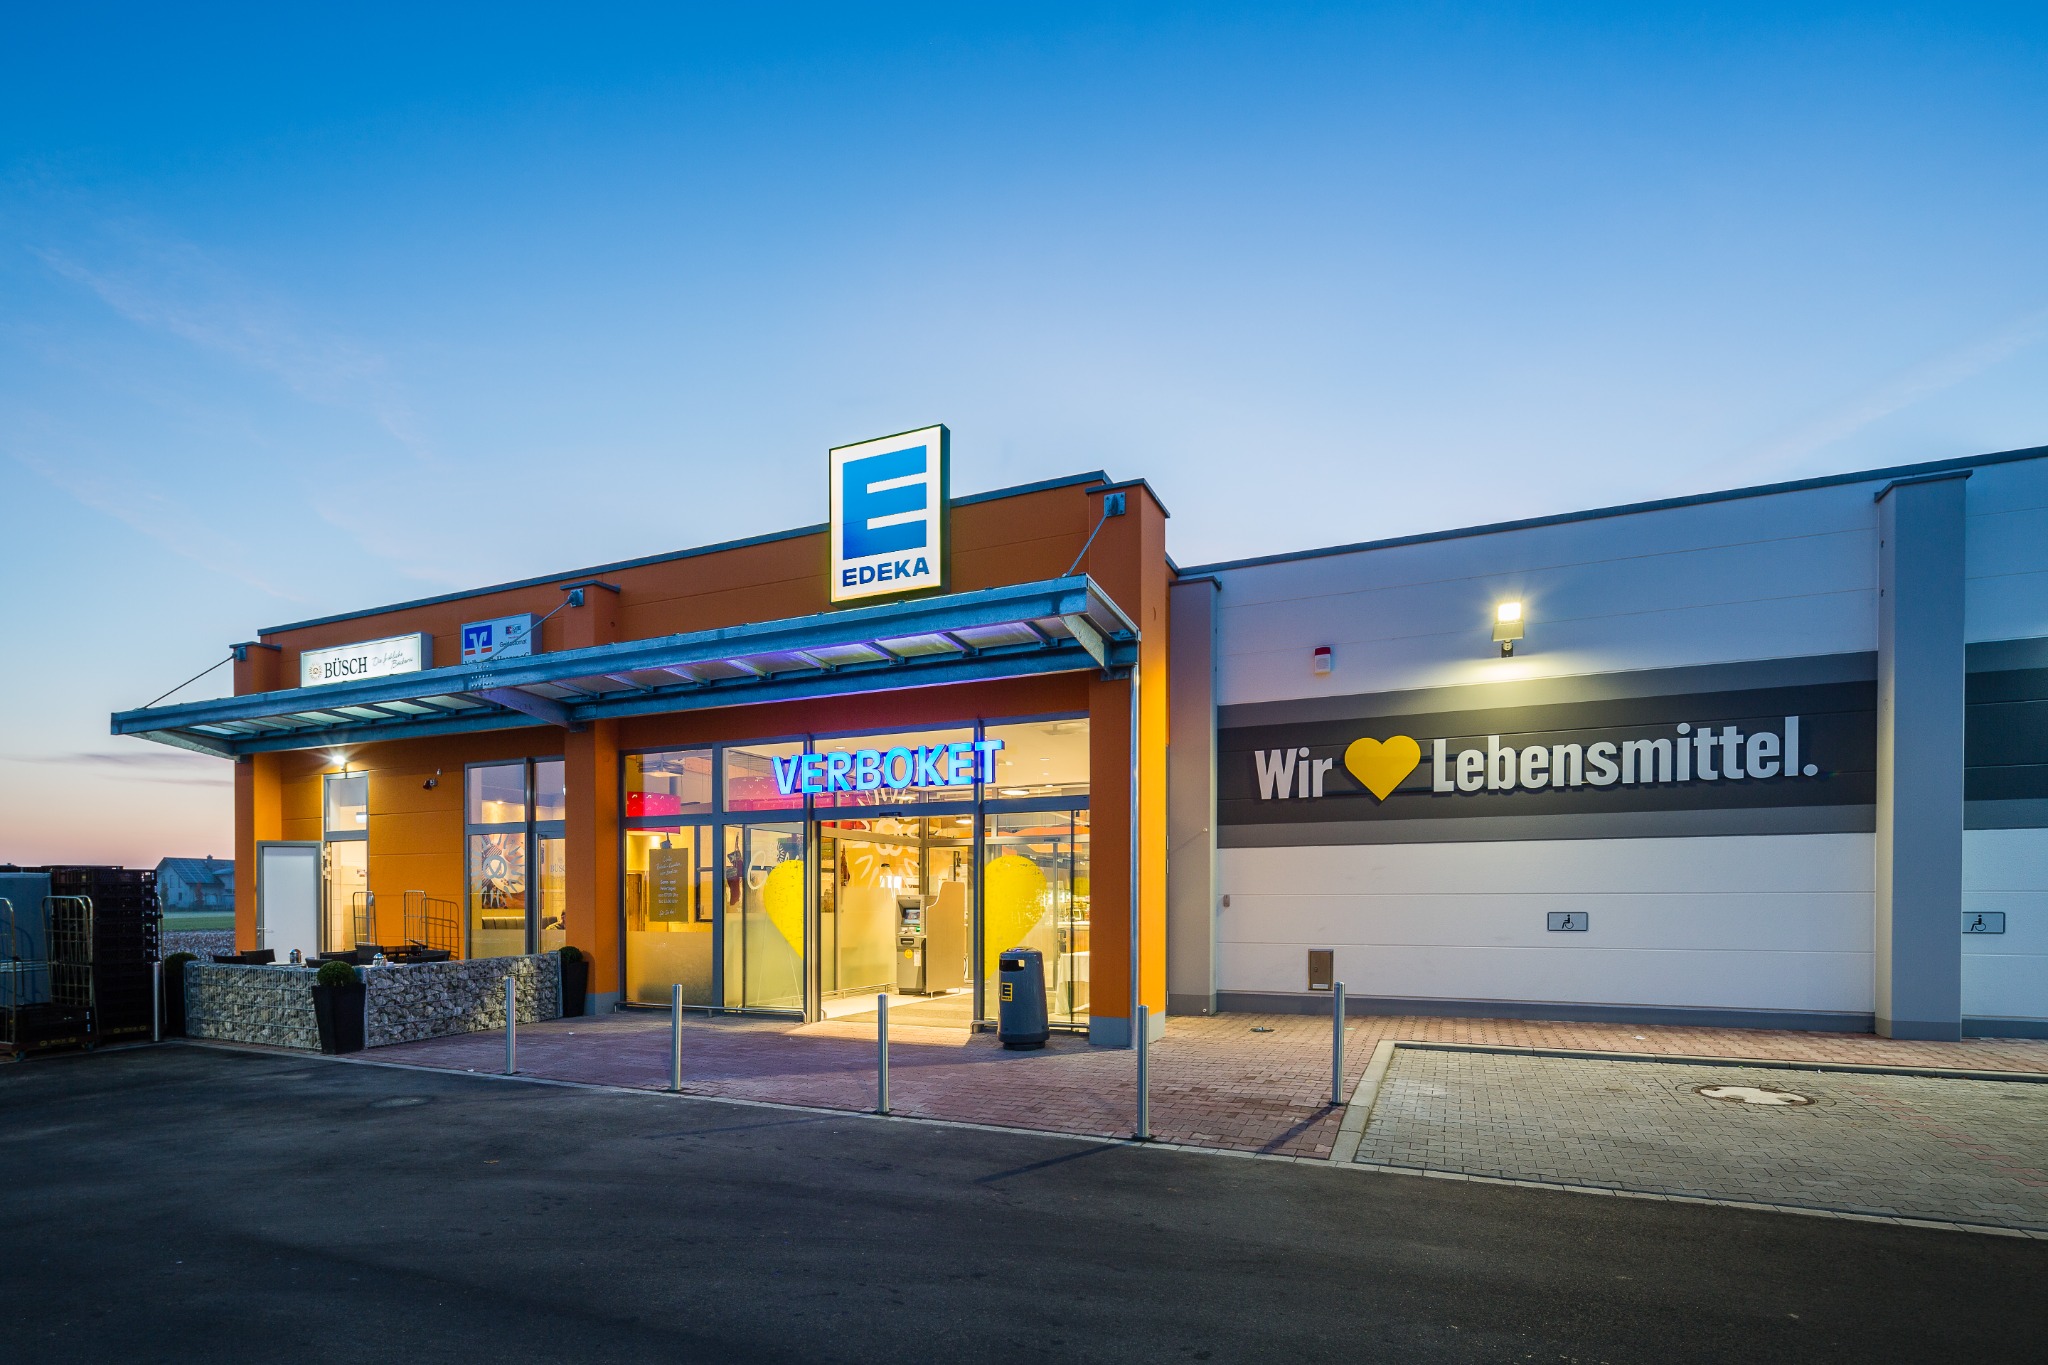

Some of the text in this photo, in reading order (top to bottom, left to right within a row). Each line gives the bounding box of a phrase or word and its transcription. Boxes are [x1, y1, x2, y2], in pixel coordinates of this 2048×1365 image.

[843, 557, 929, 587] EDEKA
[324, 657, 368, 679] BÜSCH
[772, 739, 1005, 795] VERBOKET
[1254, 715, 1819, 800] Wir Lebensmittel.
